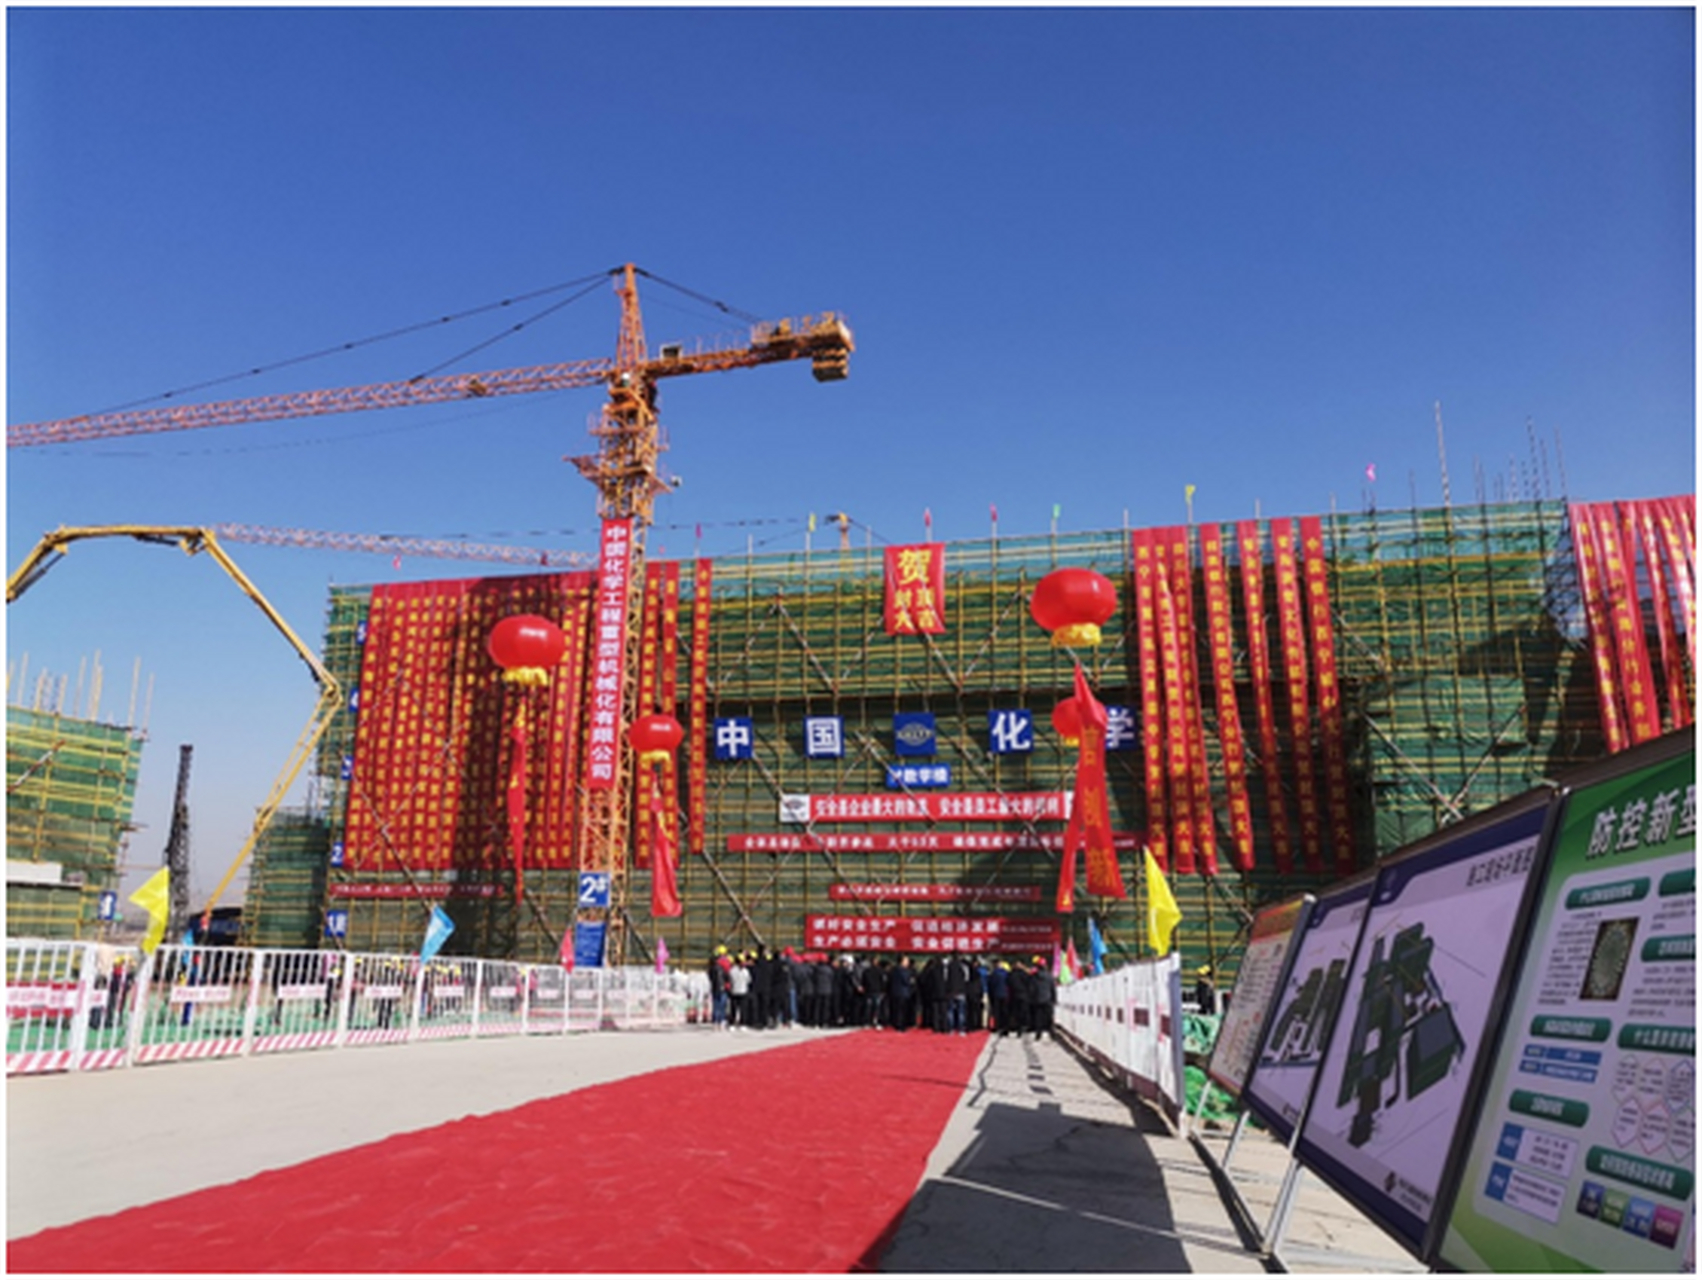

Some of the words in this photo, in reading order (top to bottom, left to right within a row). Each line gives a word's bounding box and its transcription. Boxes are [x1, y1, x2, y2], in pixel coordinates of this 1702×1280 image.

[898, 549, 932, 586] 贺
[590, 525, 628, 781] 中国化学工程重型机械化有限公司
